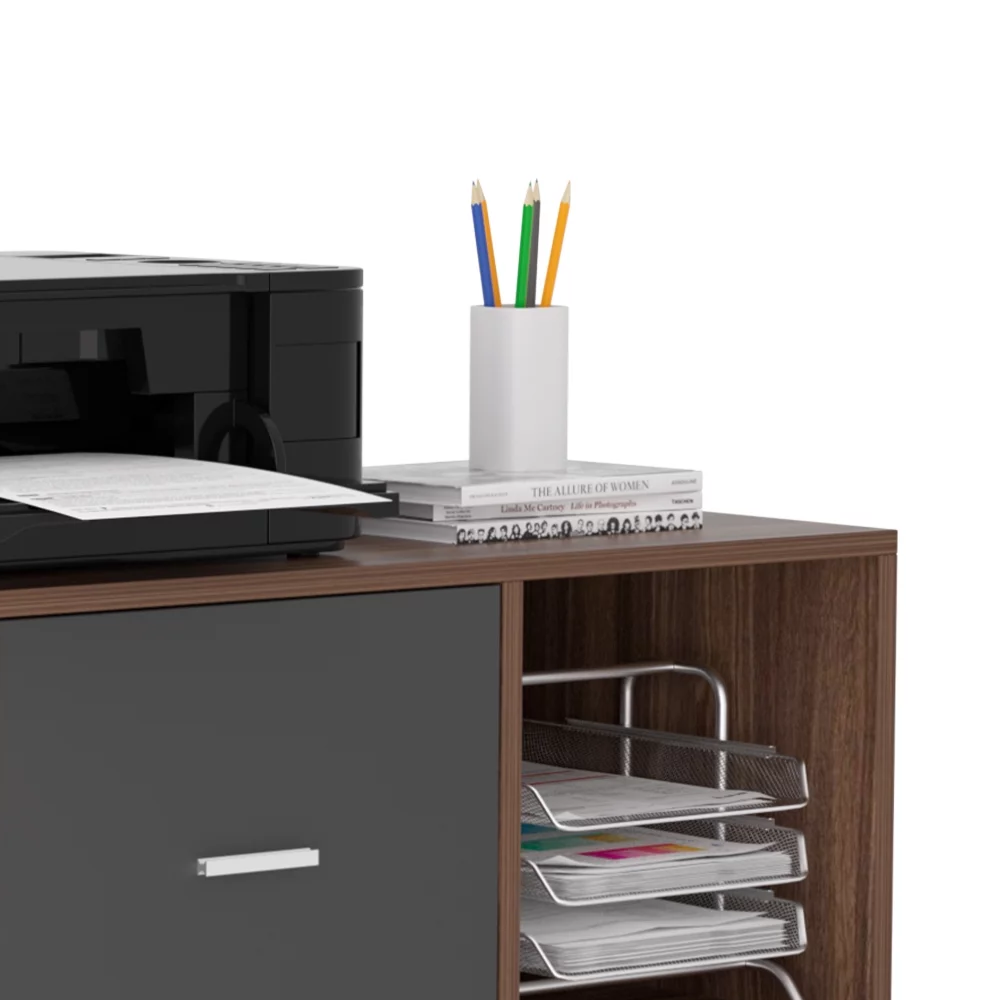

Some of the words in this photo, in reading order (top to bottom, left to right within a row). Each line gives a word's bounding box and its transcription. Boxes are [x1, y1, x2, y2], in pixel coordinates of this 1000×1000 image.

[531, 486, 552, 498] THE
[554, 483, 593, 498] ALLURE
[595, 481, 609, 494] OF
[611, 480, 650, 492] WOMEN
[501, 504, 523, 513] Linda
[524, 504, 536, 512] Mc
[537, 502, 565, 513] Cartney
[571, 501, 585, 510] Life
[594, 499, 637, 510] Photographs
